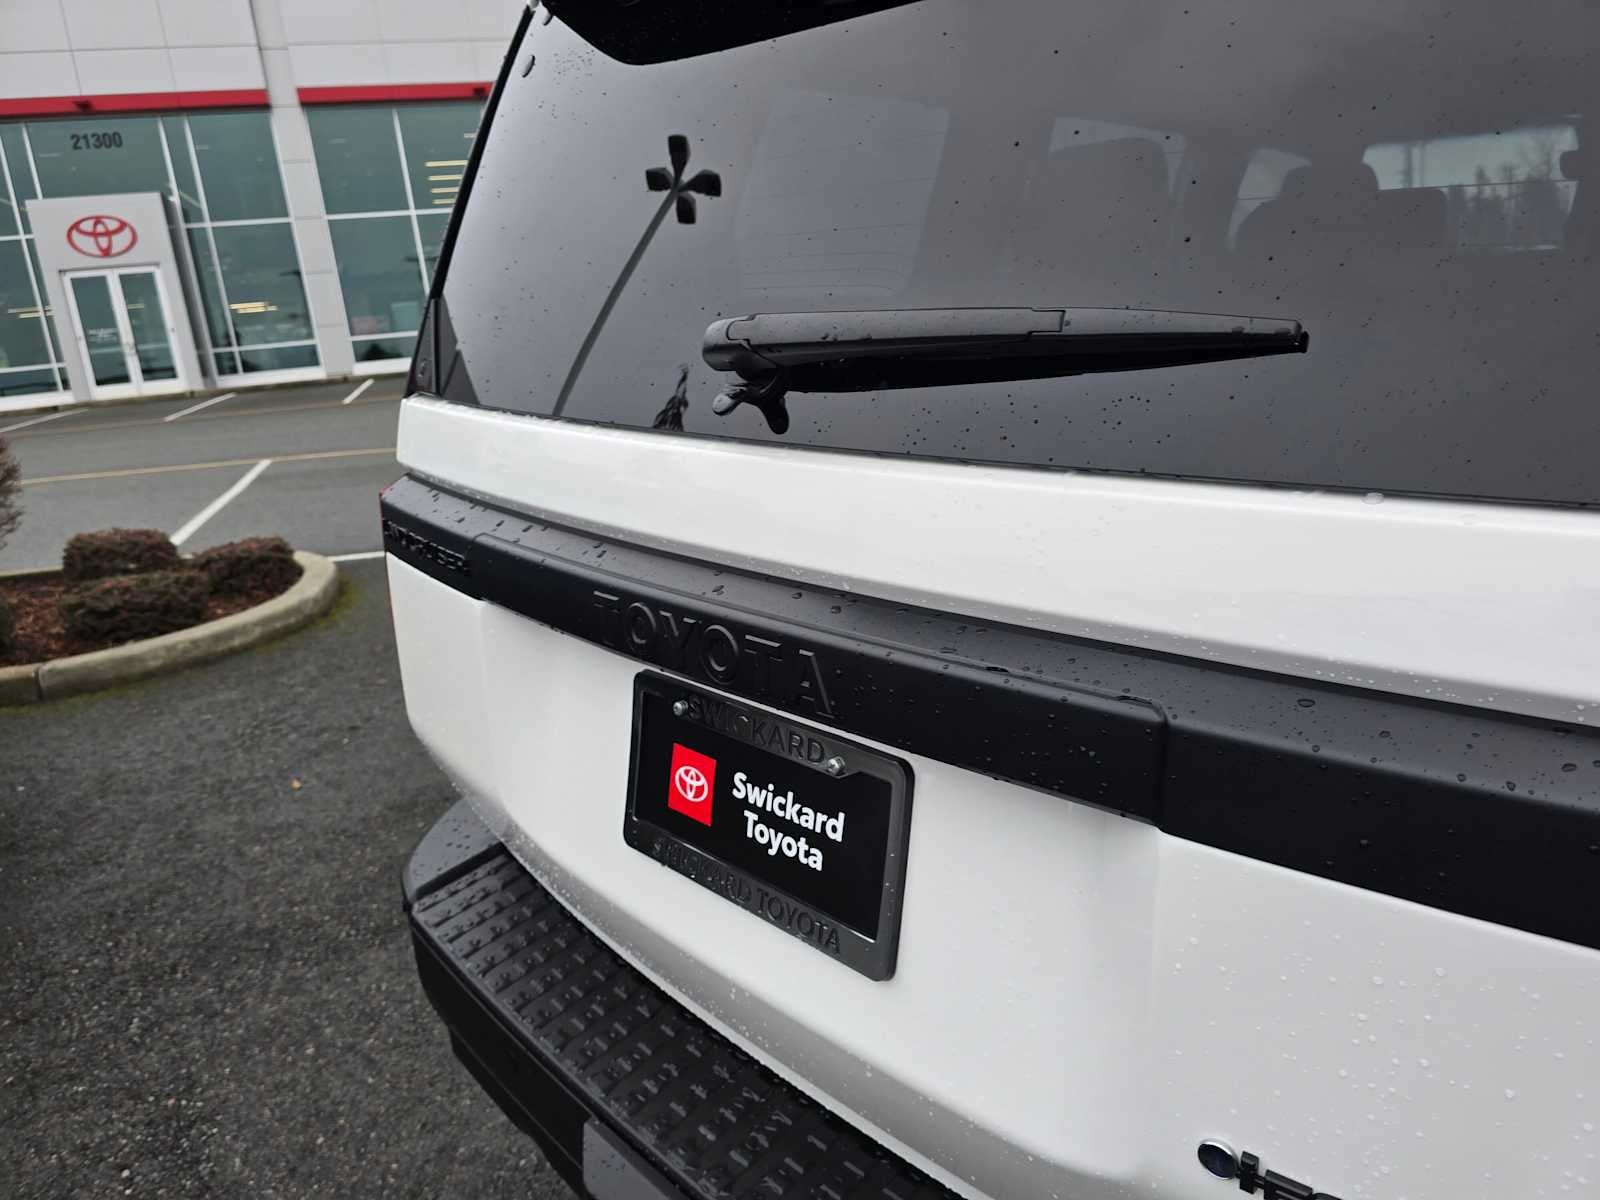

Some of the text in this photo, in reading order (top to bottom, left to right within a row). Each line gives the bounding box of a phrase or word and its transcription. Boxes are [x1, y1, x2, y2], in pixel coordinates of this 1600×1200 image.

[70, 131, 123, 151] 21300
[592, 589, 838, 720] TOYOTA
[687, 695, 826, 764] SWICKARD
[731, 771, 846, 843] Swickard
[743, 809, 824, 872] Toyota
[755, 886, 842, 956] TOYOTA
